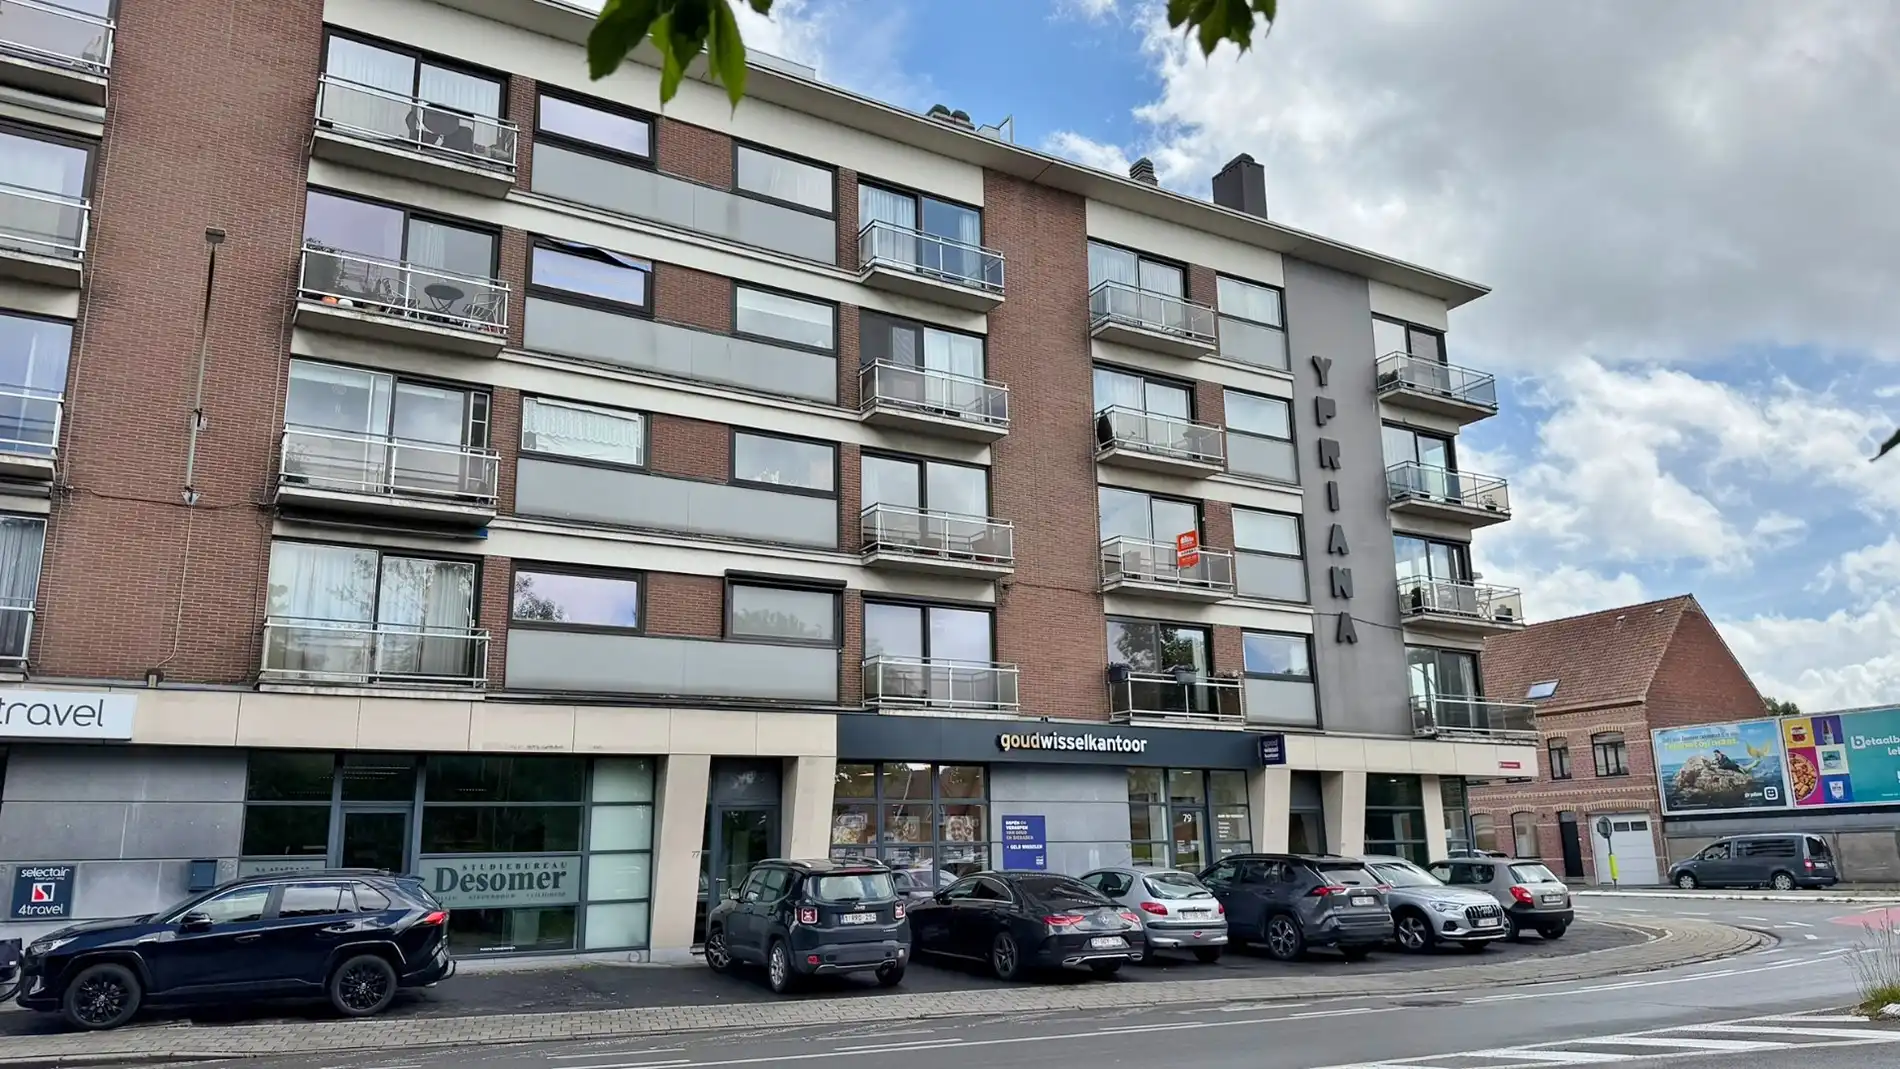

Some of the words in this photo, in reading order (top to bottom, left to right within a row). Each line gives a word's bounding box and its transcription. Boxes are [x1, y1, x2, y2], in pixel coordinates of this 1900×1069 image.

[1312, 356, 1357, 643] YPRIANA
[1000, 732, 1148, 752] goudwisselkantoor
[1183, 813, 1192, 823] 79
[21, 866, 70, 878] selectair
[433, 866, 567, 894] Desomer
[18, 903, 64, 915] 4travel
